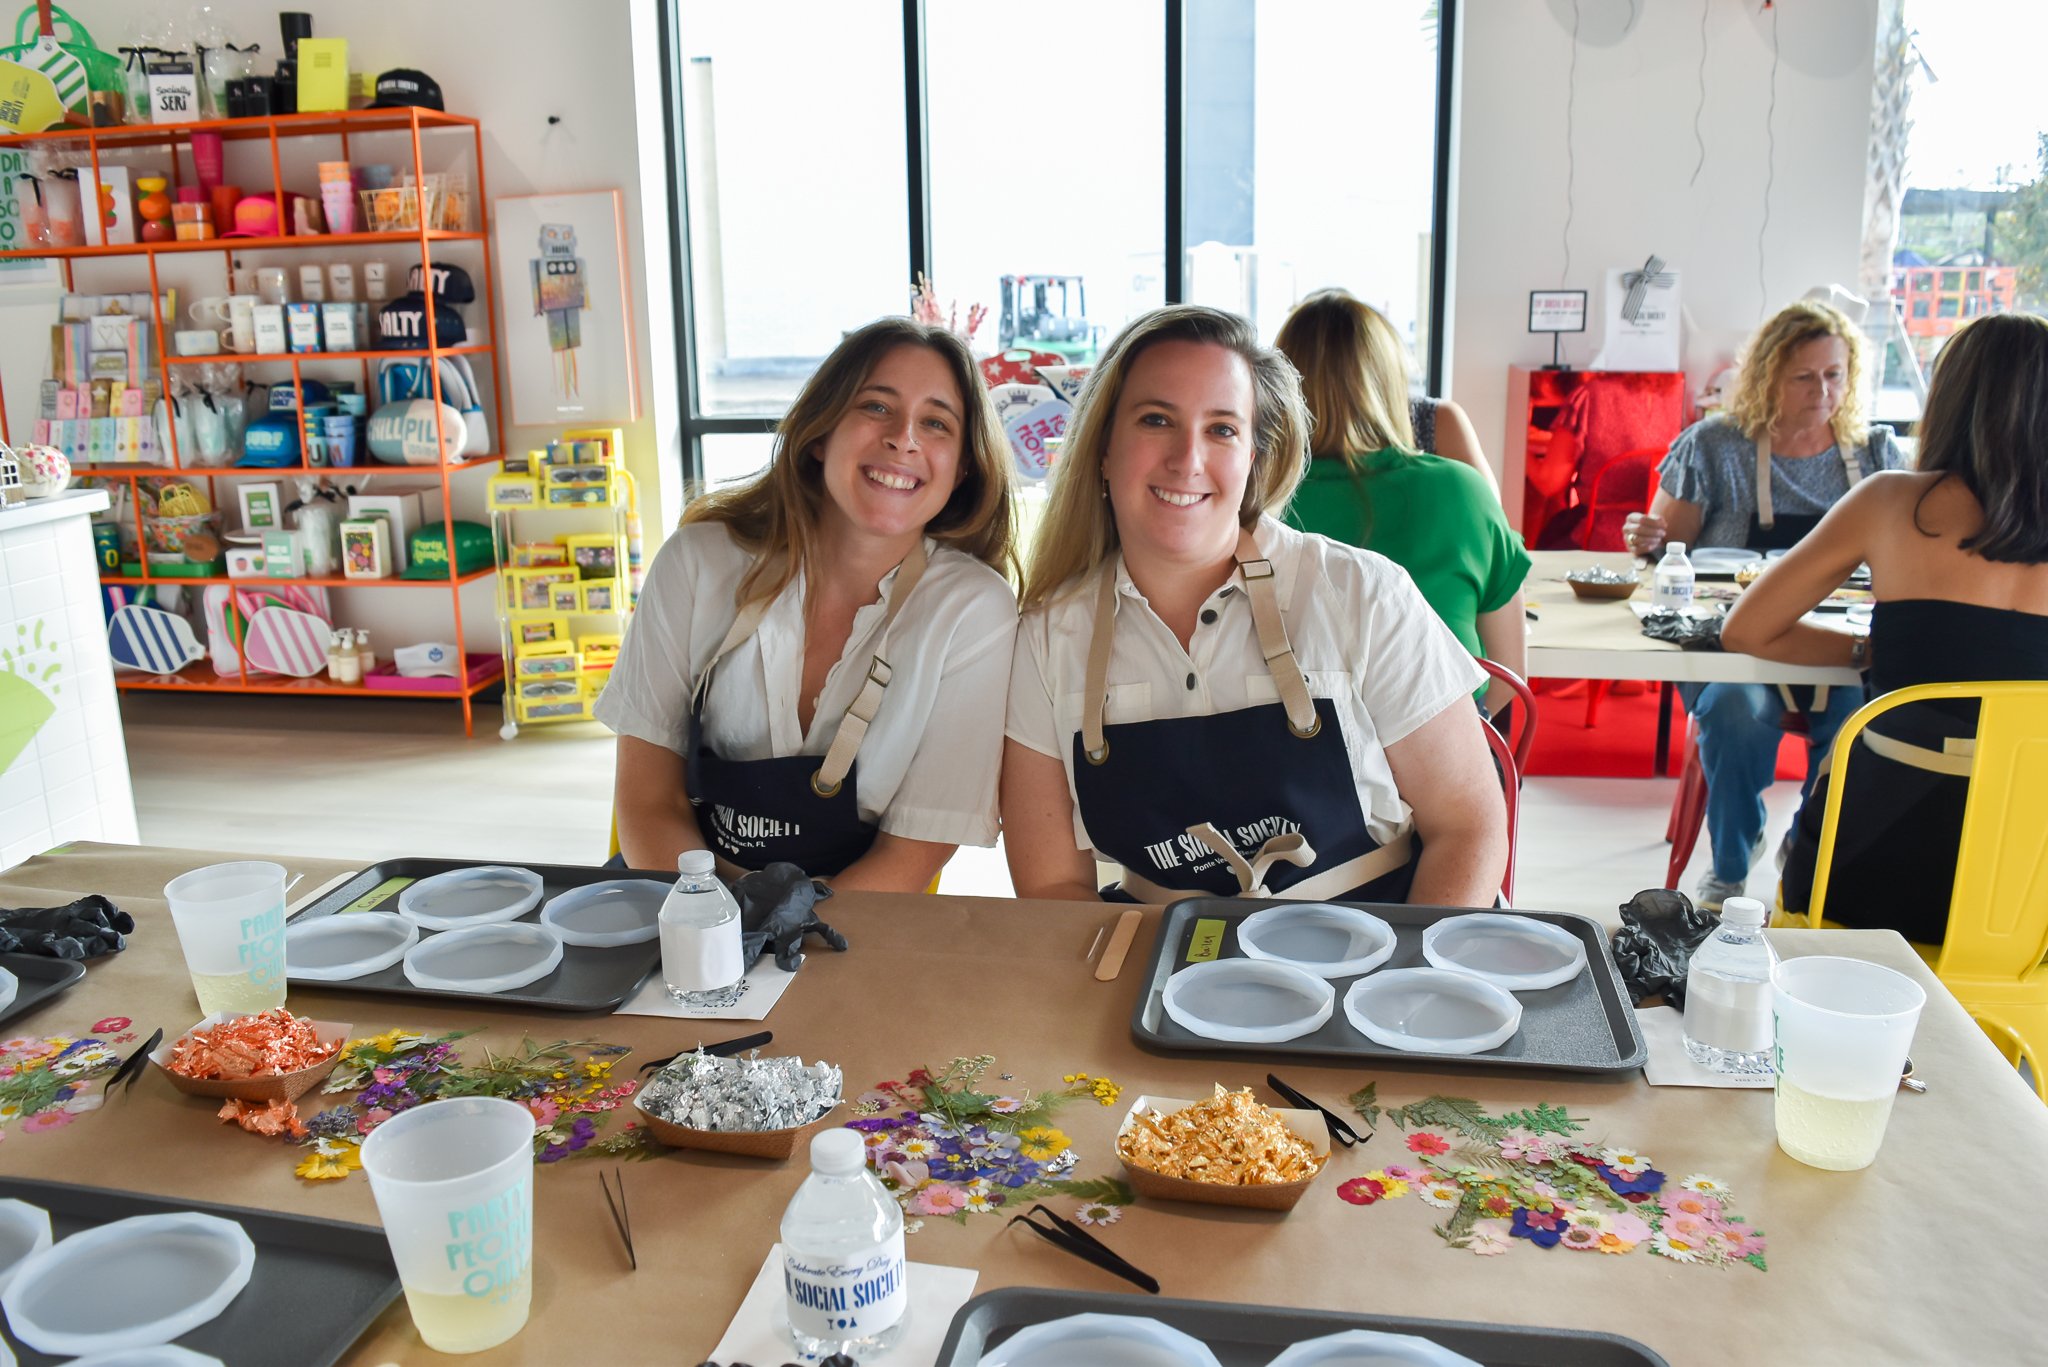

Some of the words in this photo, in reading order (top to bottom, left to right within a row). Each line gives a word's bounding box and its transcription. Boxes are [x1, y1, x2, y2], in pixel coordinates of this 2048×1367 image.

[405, 267, 450, 294] ALTY
[403, 419, 452, 443] PIL
[755, 840, 766, 848] FL
[1143, 838, 1183, 870] THE
[1177, 828, 1240, 862] SOL
[1193, 859, 1216, 874] Ponte
[238, 928, 286, 964] PEOP
